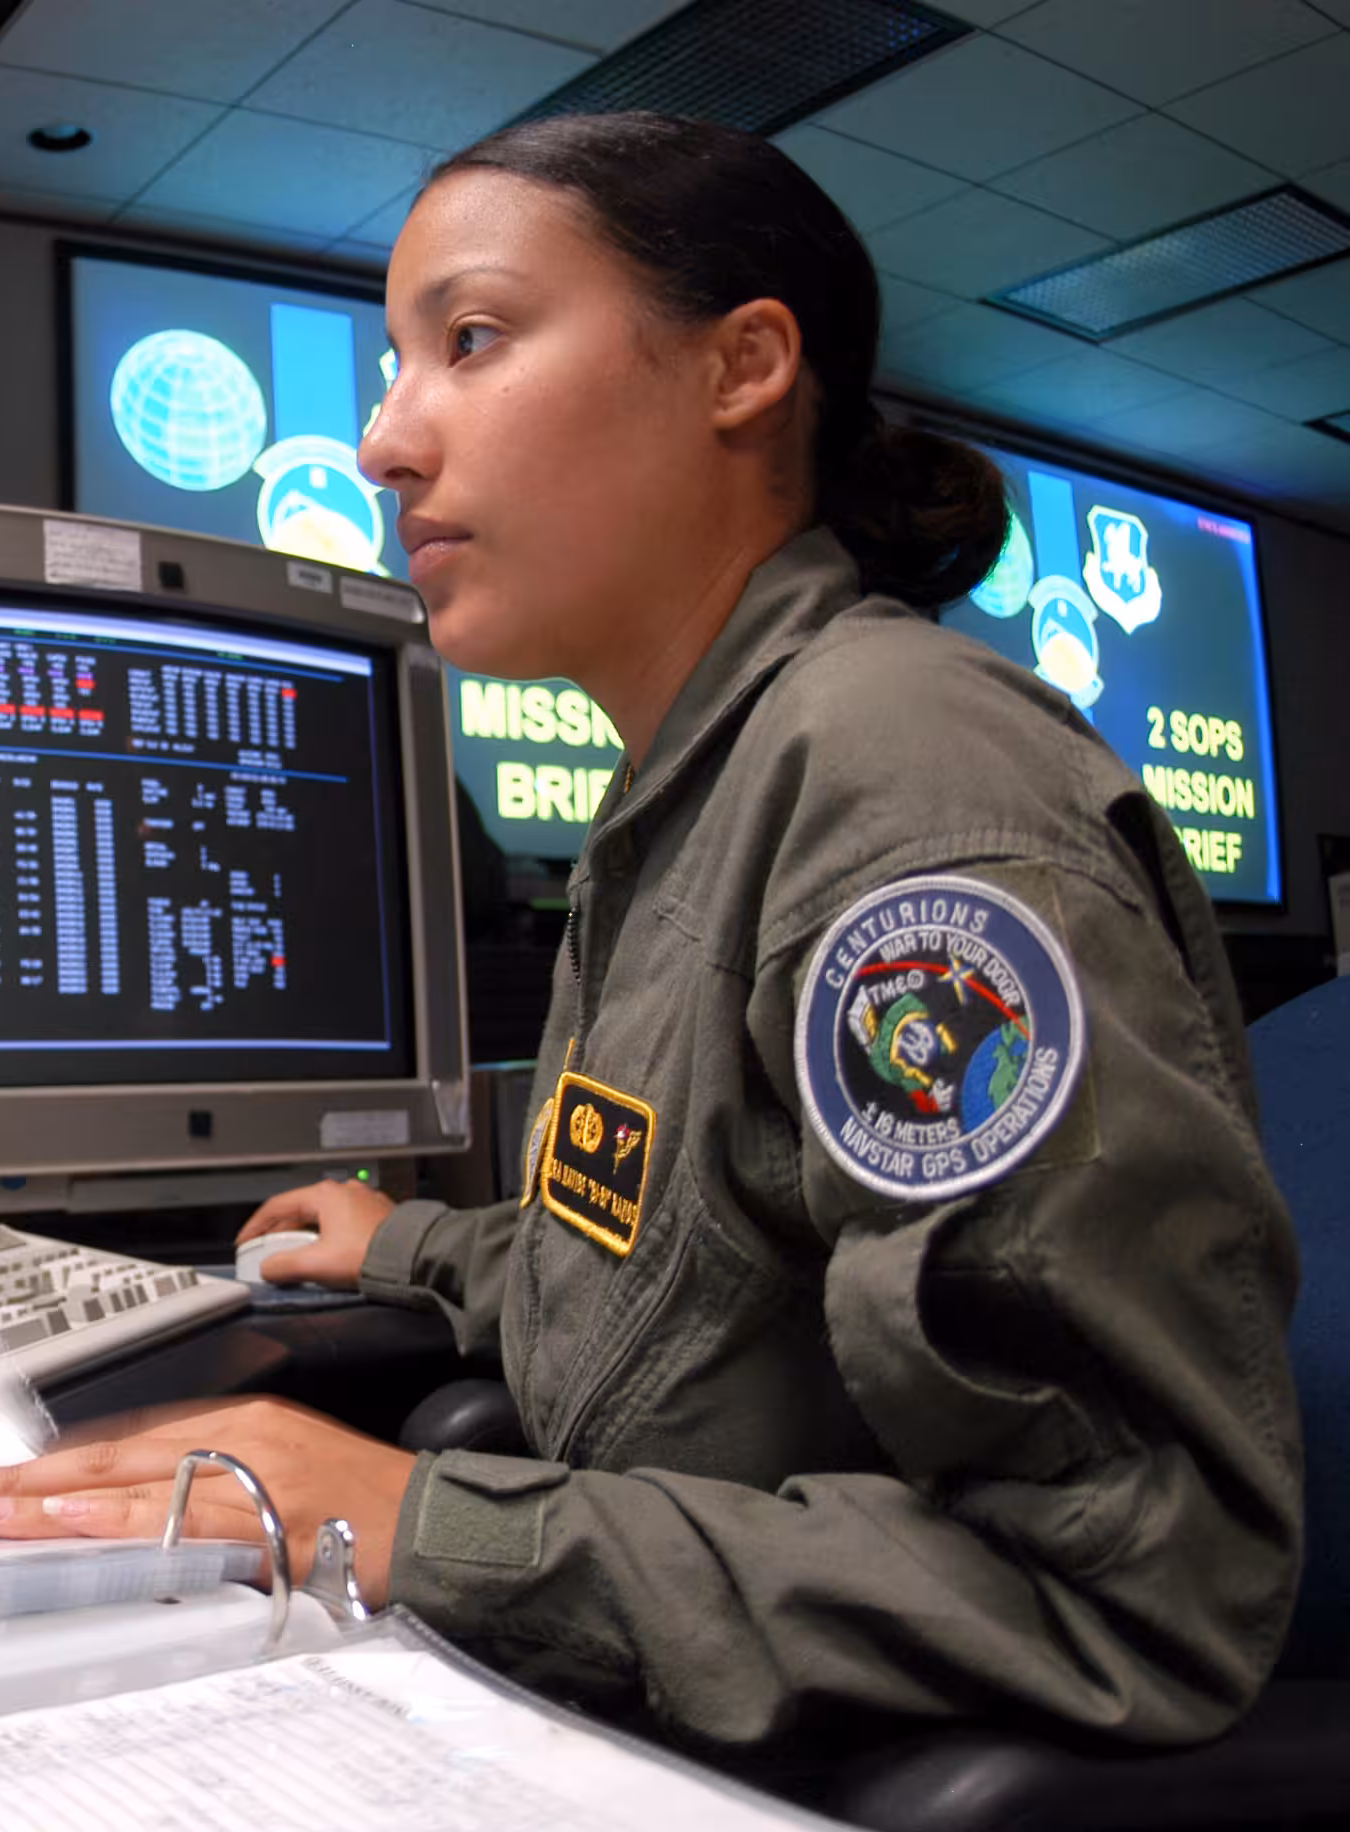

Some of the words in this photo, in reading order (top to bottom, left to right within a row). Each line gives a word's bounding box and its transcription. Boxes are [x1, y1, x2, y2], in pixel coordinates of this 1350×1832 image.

[1146, 705, 1166, 749] 2
[1169, 709, 1245, 762] SOPS
[1172, 825, 1243, 873] RIEF
[824, 898, 990, 989] CENTURIONS
[879, 932, 917, 963] WAR
[918, 931, 941, 952] TO
[946, 933, 988, 968] YOUR
[983, 959, 1021, 1007] DOOR
[839, 1115, 914, 1178] NAVSTAR
[922, 1148, 967, 1178] GPS
[973, 1046, 1059, 1161] OPERATIONS
[893, 1117, 961, 1144] METERS
